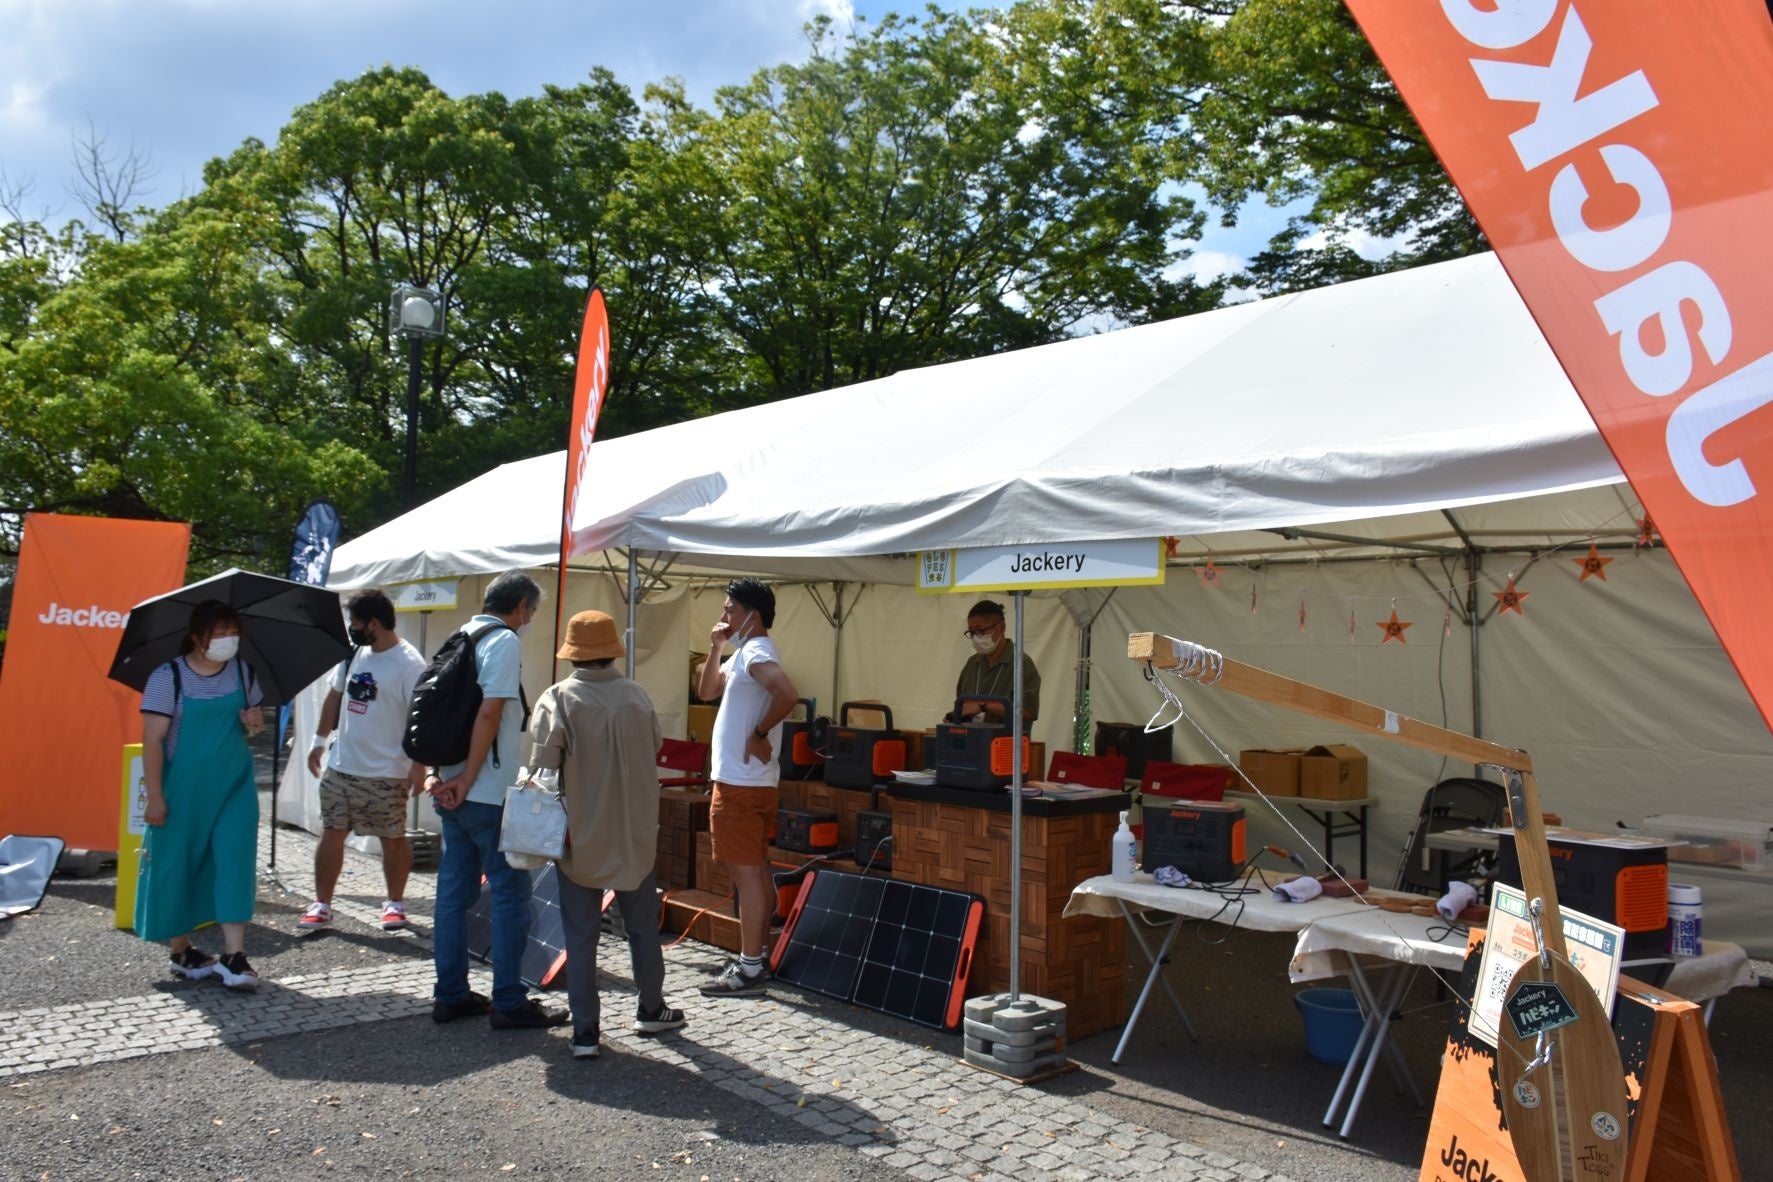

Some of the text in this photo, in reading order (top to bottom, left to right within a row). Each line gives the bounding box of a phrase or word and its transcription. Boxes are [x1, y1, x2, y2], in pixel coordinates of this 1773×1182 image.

[1011, 552, 1086, 573] Jackery
[1516, 989, 1546, 1006] Jackery
[1441, 1134, 1504, 1182] Jack
